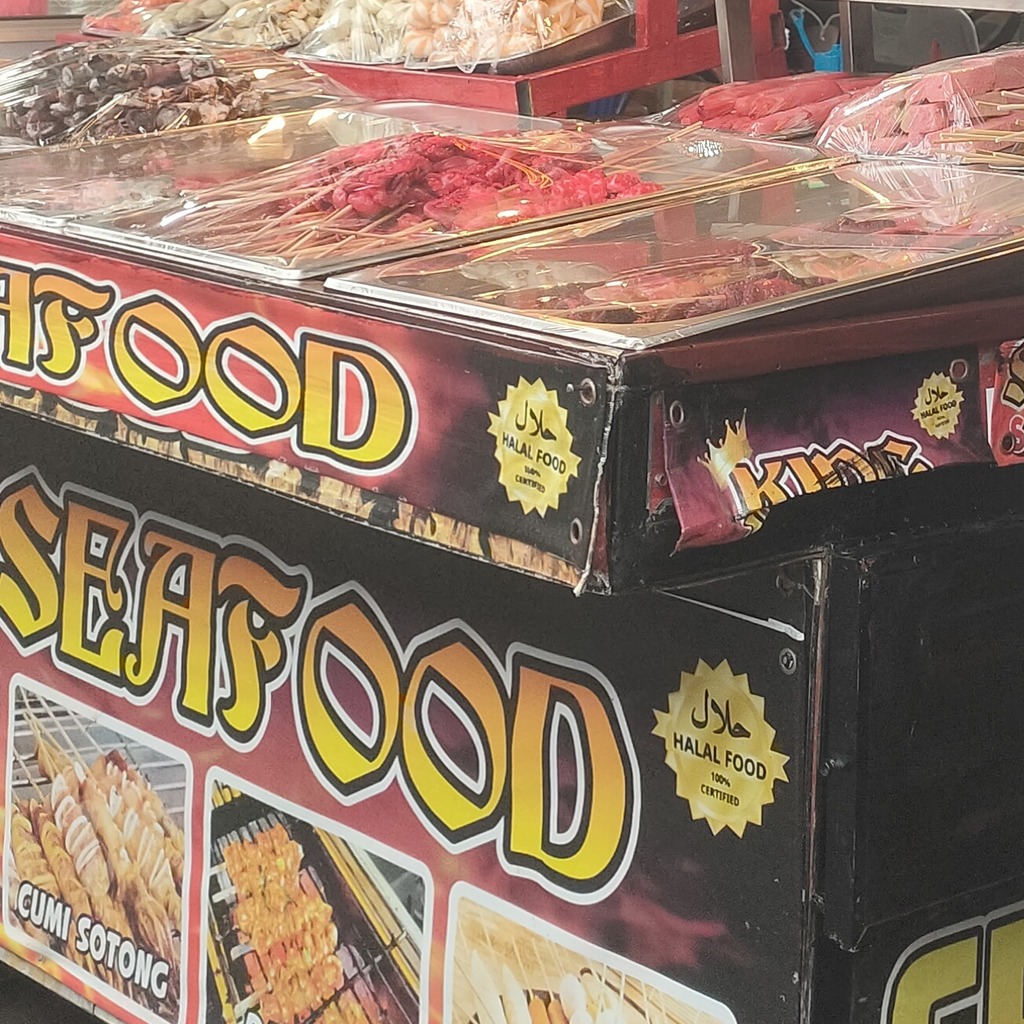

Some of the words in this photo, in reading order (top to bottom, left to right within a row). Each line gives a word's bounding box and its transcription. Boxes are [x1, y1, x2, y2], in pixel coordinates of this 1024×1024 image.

[515, 399, 557, 442] حلال
[939, 399, 957, 412] FOOD
[502, 432, 534, 461] HALAL
[536, 448, 567, 475] FOOD
[0, 474, 632, 896] SEAFOOD
[691, 688, 751, 739] حلال
[673, 732, 721, 765] HALAL
[725, 749, 767, 781] FOOD
[700, 783, 740, 807] CERTIFIED
[711, 771, 731, 788] 100%
[17, 882, 71, 942] CUMI
[75, 915, 170, 999] SOTONG
